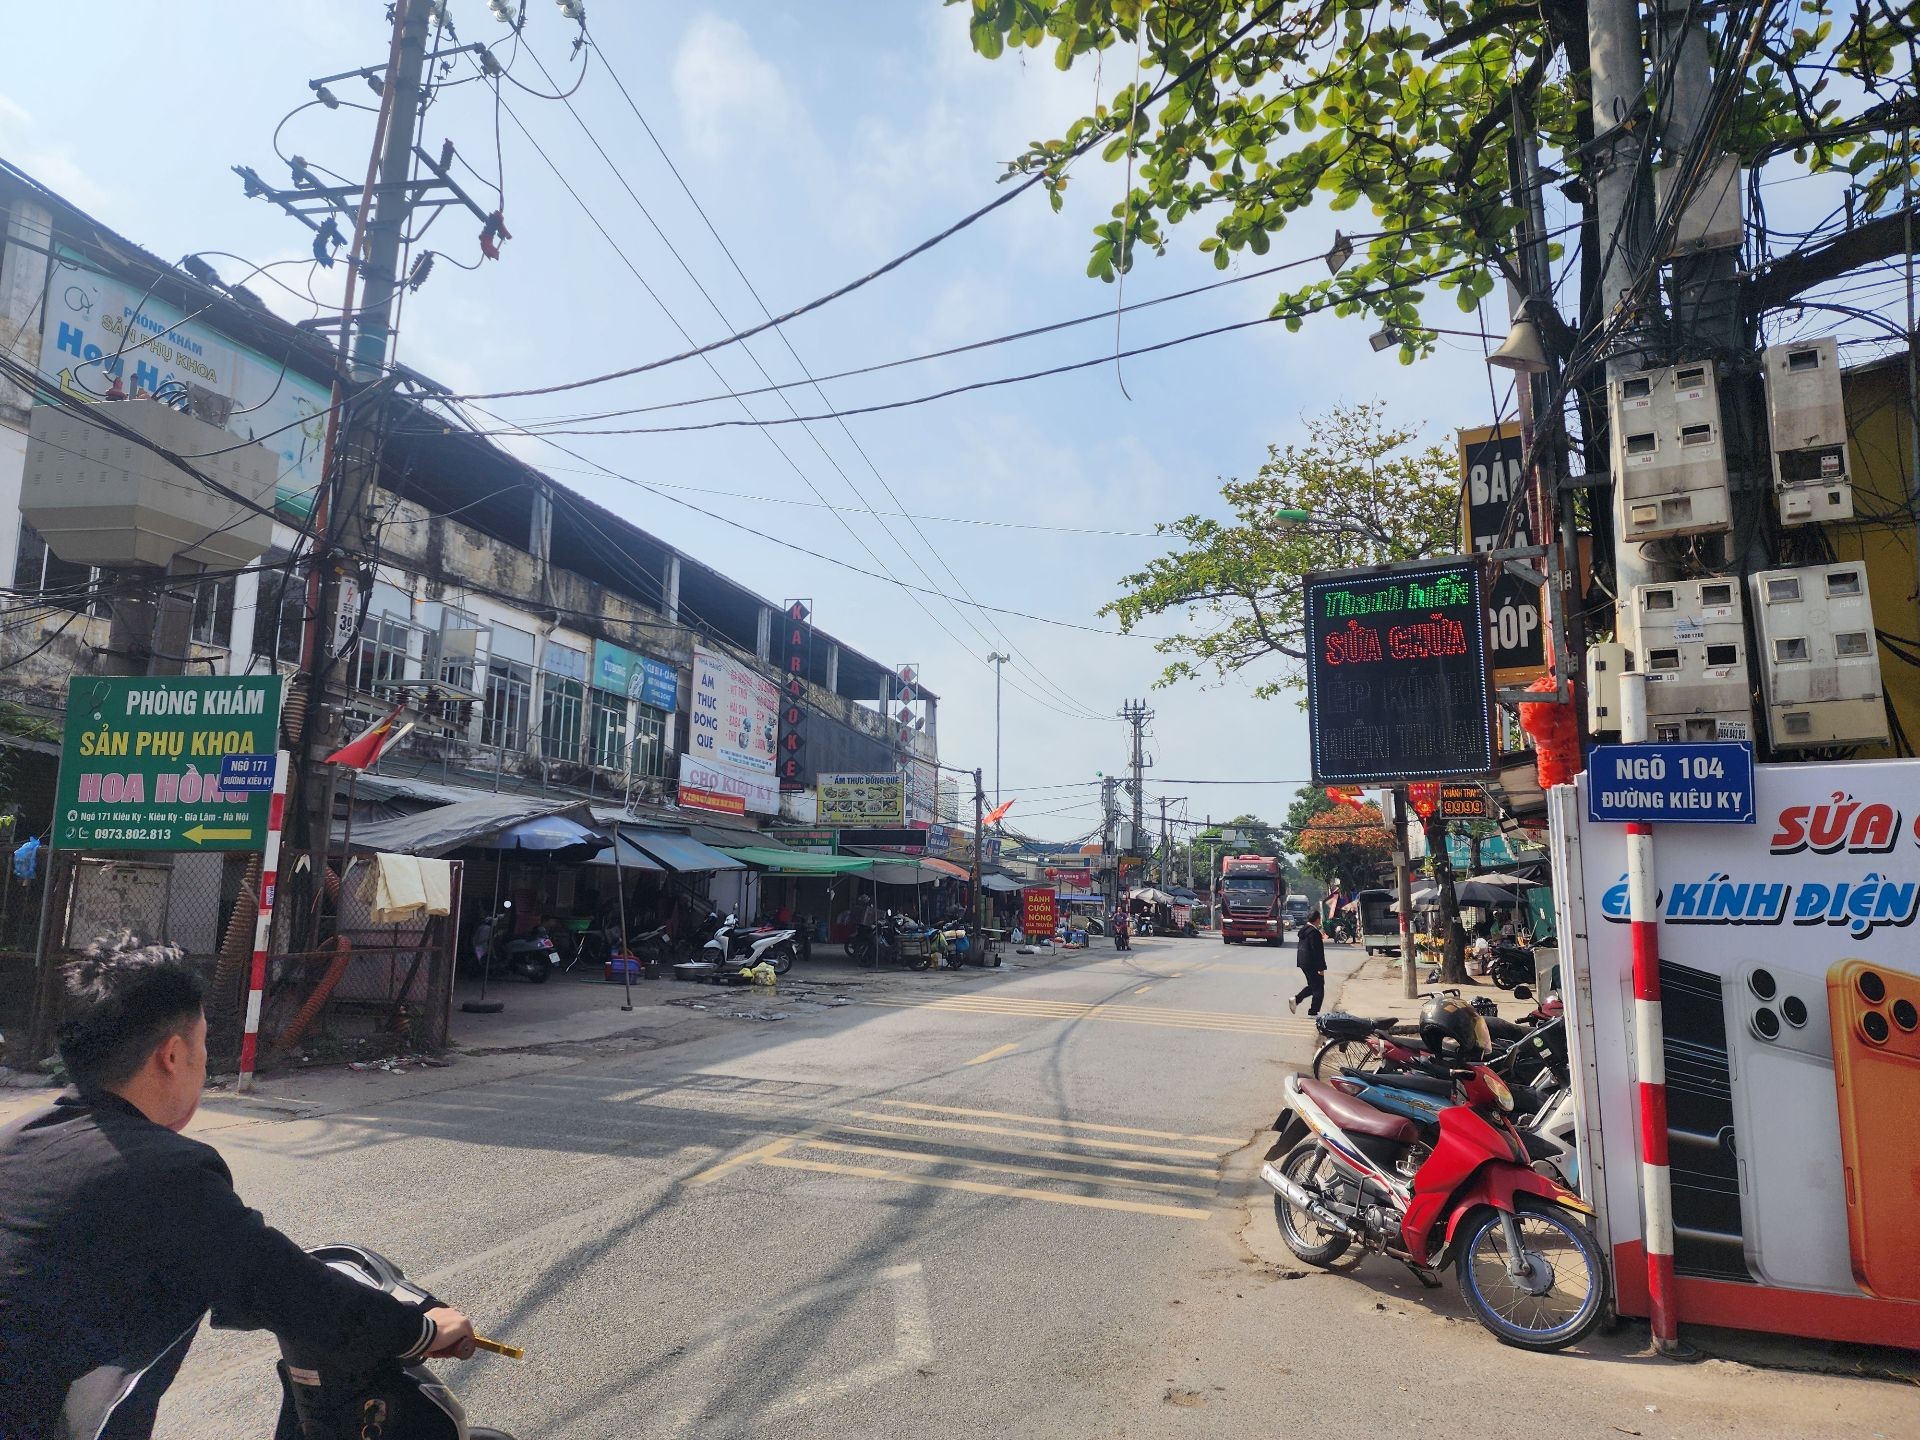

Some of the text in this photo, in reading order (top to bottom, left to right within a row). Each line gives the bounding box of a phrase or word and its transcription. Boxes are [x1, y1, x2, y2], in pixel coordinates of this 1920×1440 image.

[175, 353, 218, 384] KHOA
[1325, 613, 1468, 666] SỬA CHỮA
[126, 684, 266, 716] PHÒNG KHÁM
[786, 605, 802, 776] KARAOKE
[79, 723, 255, 762] SẢN PHỤ KHOA
[231, 757, 268, 772] NGÕ 171
[1616, 753, 1725, 780] NGÕ 104
[78, 773, 145, 804] HOA
[223, 773, 246, 785] ĐƯỜNG
[1444, 800, 1483, 814] 9999
[1601, 786, 1743, 812] ĐƯỜNG KIÊU KỴ
[80, 812, 249, 823] Ngõ 171 Kiêu Kỵ Kiêu Kỵ Gia Lâm Hà Nội
[1770, 791, 1897, 851] SỬA
[94, 828, 172, 840] 0973.802.813
[1027, 902, 1051, 912] CUỐN
[1028, 893, 1050, 902] BÁNH
[1666, 873, 1787, 920] KÍNH
[1794, 873, 1917, 934] ĐIỆN
[1028, 912, 1053, 922] NÓNG
